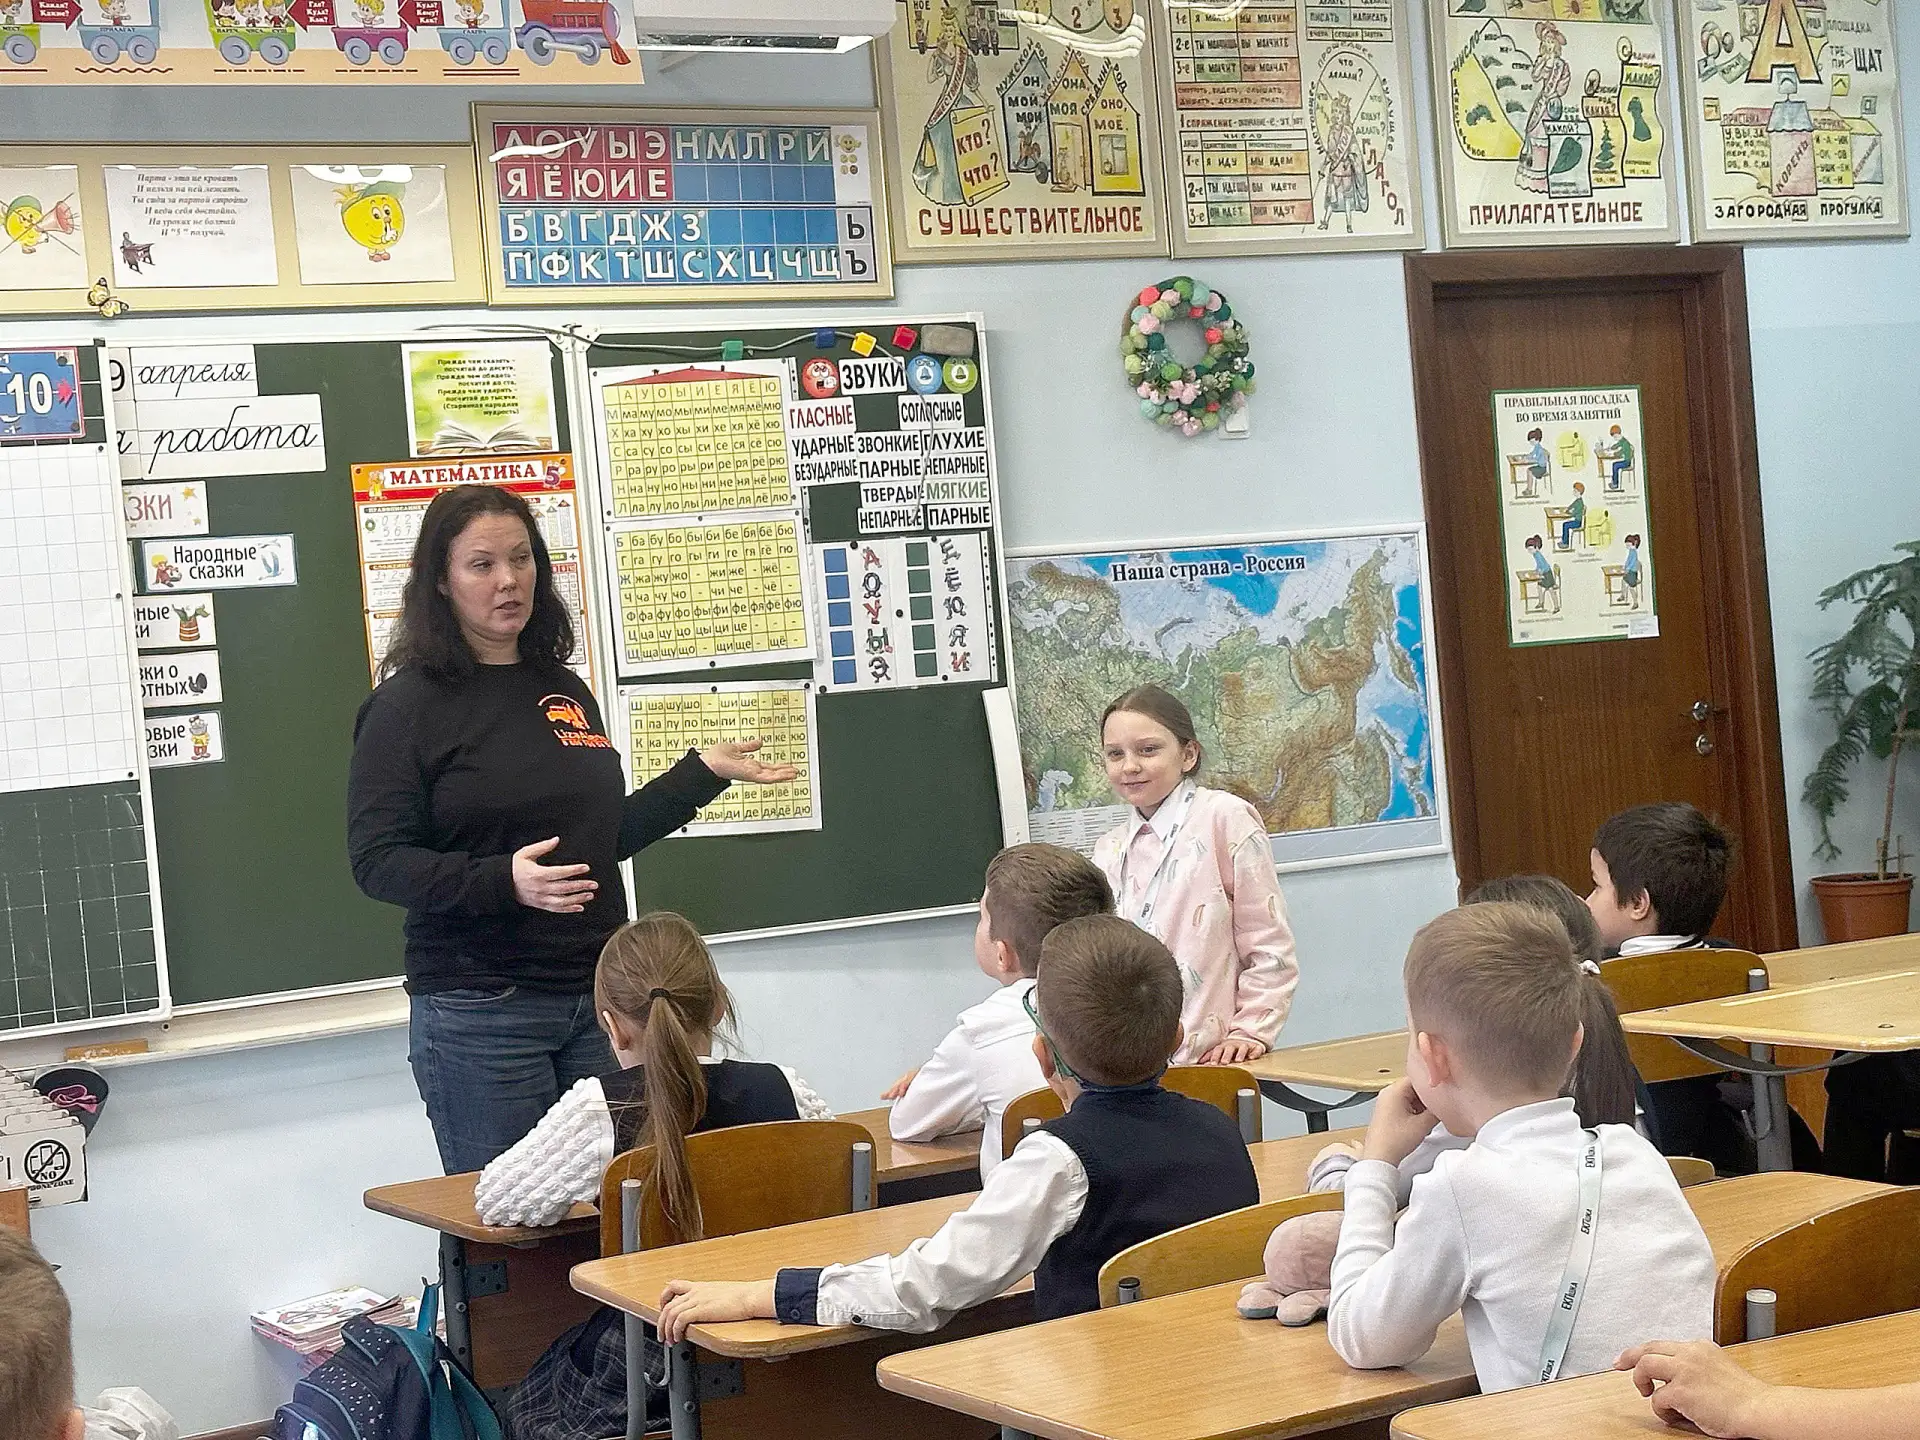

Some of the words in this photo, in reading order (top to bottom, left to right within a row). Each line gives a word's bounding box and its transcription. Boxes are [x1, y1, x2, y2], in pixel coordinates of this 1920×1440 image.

[1071, 6, 1082, 28] 2
[1112, 7, 1123, 28] 3
[1853, 48, 1883, 73] ЩАТ
[1100, 98, 1128, 113] ОНО,
[956, 117, 992, 156] КТО?
[963, 151, 1000, 188] ЧТО?
[1775, 139, 1809, 194] КОРЕНЬ
[918, 205, 1143, 238] СУЩЕСТВИТЕЛЬНОЕ
[1469, 201, 1643, 226] ПРИЛАГАТЕЛЬНОЕ
[1714, 203, 1807, 219] ЗАГОРОДНАЯ
[1820, 202, 1881, 216] ПРОГУЛКА
[110, 359, 125, 392] 9
[138, 362, 251, 398] апреля
[842, 362, 906, 390] ЗВУКИ
[6, 371, 53, 415] 10
[1504, 395, 1577, 409] ПРАВИЛЬНАЯ
[1579, 393, 1631, 406] ПОСАДКА
[789, 404, 854, 430] ГЛАСНЫЕ
[1516, 412, 1530, 423] ВО
[1531, 411, 1568, 422] ВРЕМЯ
[1570, 407, 1621, 421] ЗАНЯТИЙ
[147, 405, 318, 475] работа
[626, 447, 638, 456] са
[643, 446, 655, 457] су
[660, 445, 673, 454] со
[678, 444, 693, 453] сы
[698, 443, 711, 452] си
[716, 442, 728, 451] се
[733, 440, 745, 450] ся
[750, 437, 762, 448] сё
[767, 438, 782, 448] сю
[792, 434, 856, 460] УДАРНЫЕ
[857, 434, 920, 454] ЗВОНКИЕ
[923, 430, 985, 451] ГЛУХИЕ
[390, 463, 538, 486] МАТЕМАТИКА
[794, 458, 858, 482] БЕЗУДАРНЫЕ
[859, 458, 922, 479] ПАРНЫЕ
[924, 455, 986, 476] НЕПАРНЫЕ
[863, 484, 925, 504] ТВЕРДЫЕ
[926, 480, 988, 500] МЯГКИЕ
[860, 508, 923, 530] НЕПАРНЫЕ
[929, 505, 991, 527] ПАРНЫЕ
[631, 535, 645, 547] ба
[650, 533, 664, 547] бу
[668, 532, 682, 544] бо
[686, 531, 703, 543] бы
[706, 529, 720, 541] би
[725, 528, 739, 540] бе
[743, 527, 757, 538] бя
[759, 526, 773, 537] бё
[777, 524, 794, 536] бю
[173, 545, 257, 566] Народные
[189, 563, 245, 580] сказки
[1112, 563, 1165, 583] Наша
[1170, 560, 1231, 582] страна
[1246, 554, 1306, 574] Россия
[168, 665, 178, 678] о
[648, 701, 664, 711] ша
[666, 701, 681, 712] шу
[683, 700, 700, 710] шо
[40, 1170, 57, 1181] NO
